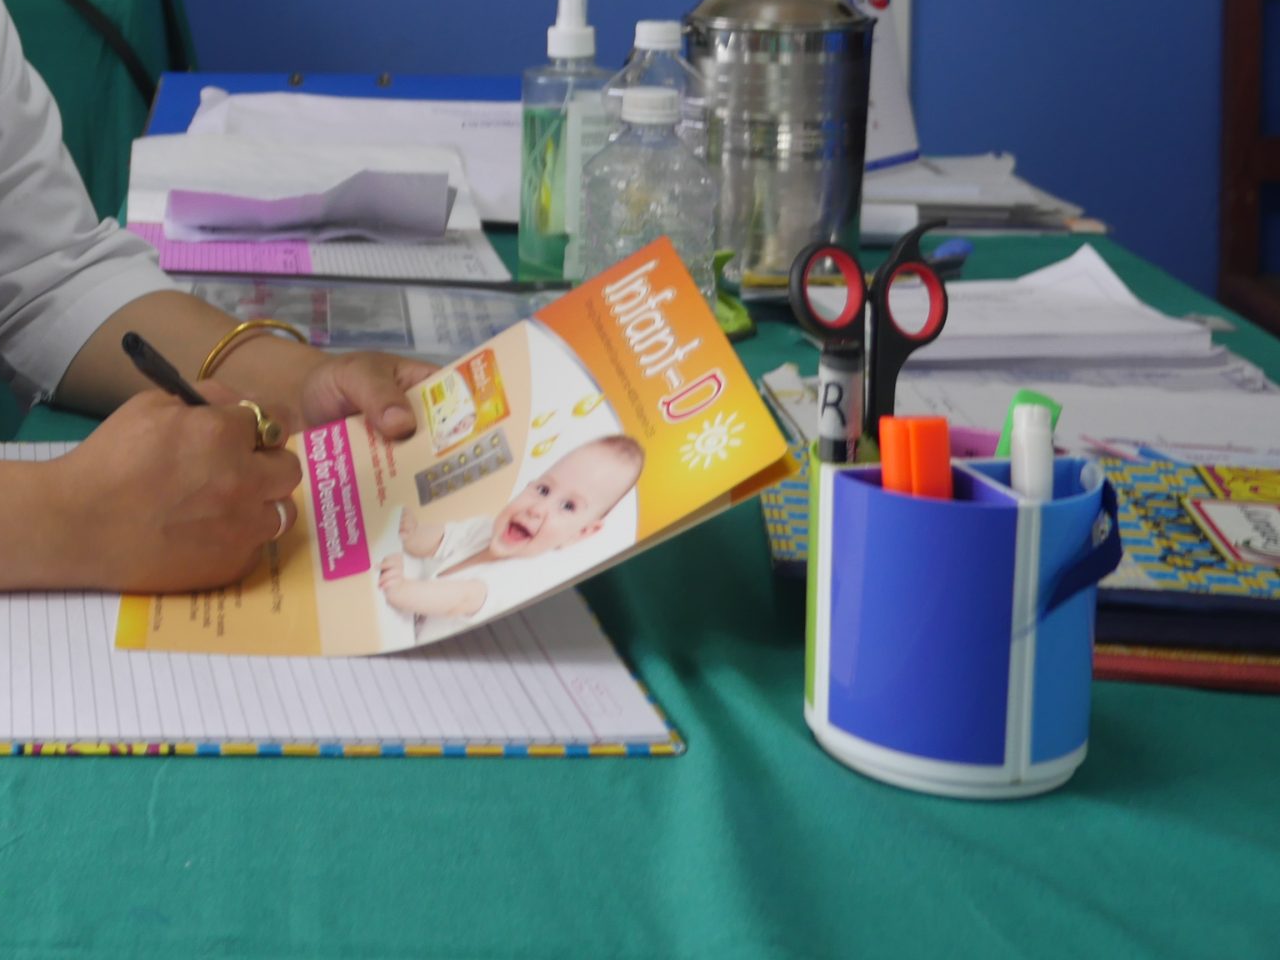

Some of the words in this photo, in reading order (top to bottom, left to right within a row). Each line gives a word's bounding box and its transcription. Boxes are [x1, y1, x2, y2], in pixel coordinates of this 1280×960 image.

[603, 259, 725, 423] Infant-D
[821, 381, 847, 428] R
[309, 428, 328, 461] Drop
[315, 459, 333, 481] for
